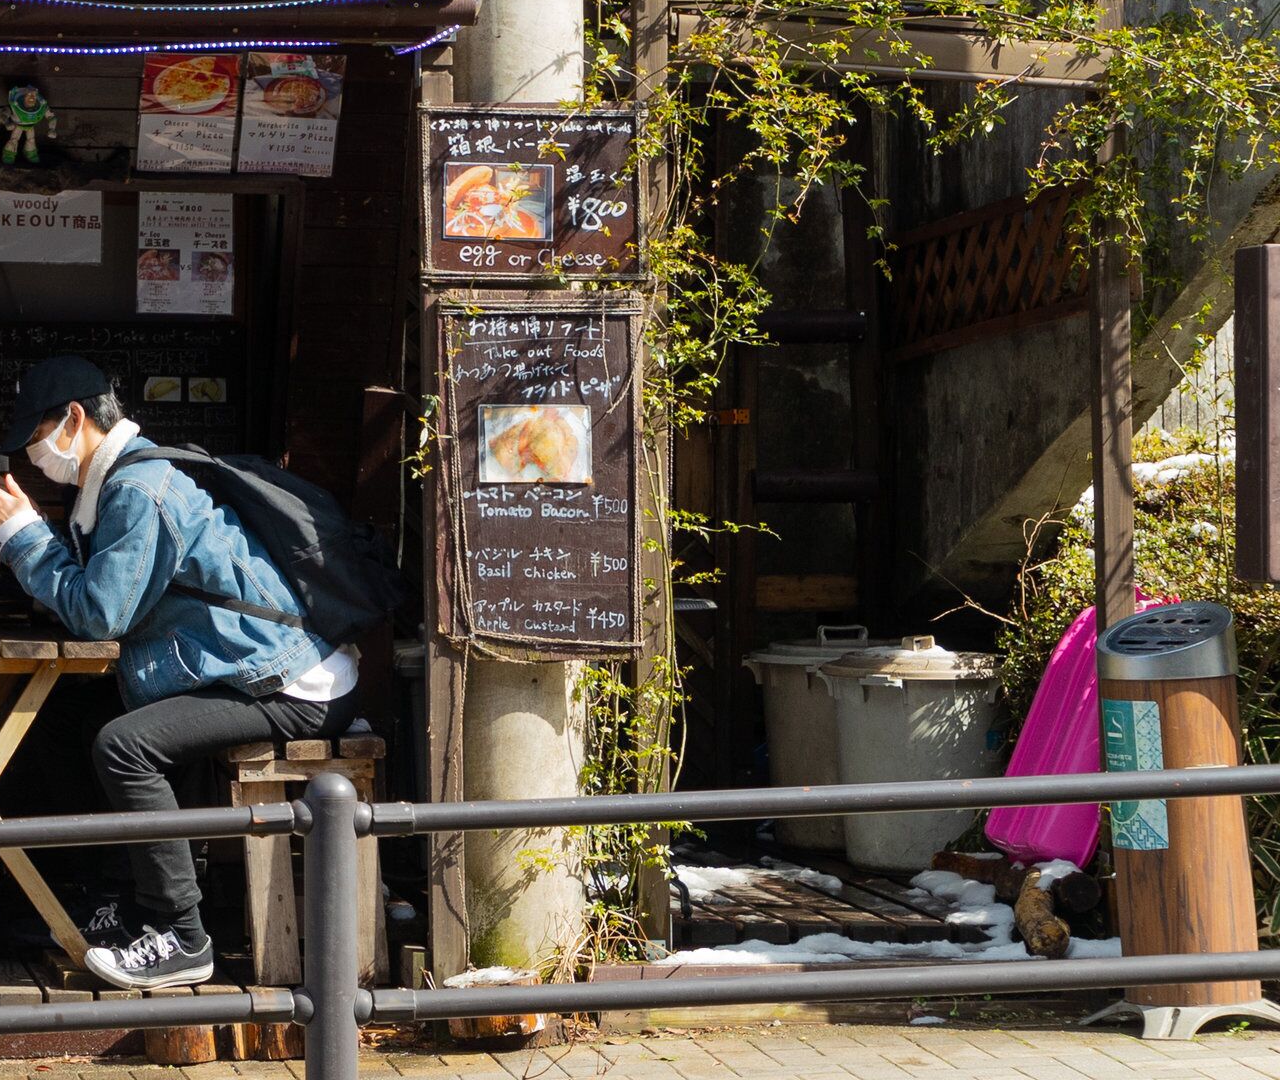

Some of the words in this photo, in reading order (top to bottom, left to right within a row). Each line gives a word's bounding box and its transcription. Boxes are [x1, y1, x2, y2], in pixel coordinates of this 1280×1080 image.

[561, 121, 584, 133] Take
[586, 121, 604, 133] out
[167, 142, 195, 152] ¥1150
[268, 143, 296, 153] ¥1150
[12, 196, 60, 213] woody
[567, 193, 628, 232] ¥800
[459, 244, 503, 268] egg
[508, 254, 532, 267] or
[537, 248, 608, 268] Cheese
[468, 316, 603, 340] お持ち帰りフード
[483, 345, 520, 361] Take
[527, 346, 553, 359] out
[563, 343, 606, 359] Foods
[472, 484, 515, 502] トマト
[524, 485, 583, 502] ベーコン
[477, 502, 534, 518] Tomato
[540, 502, 591, 518] Bacon
[592, 494, 629, 520] ¥500
[474, 547, 524, 561] バジル
[528, 546, 572, 563] チキン
[477, 561, 513, 579] Basil
[590, 550, 628, 578] ¥500
[473, 597, 525, 613] アップル
[532, 598, 583, 617] カスタード
[476, 615, 511, 632] Apple
[586, 607, 625, 630] ¥450
